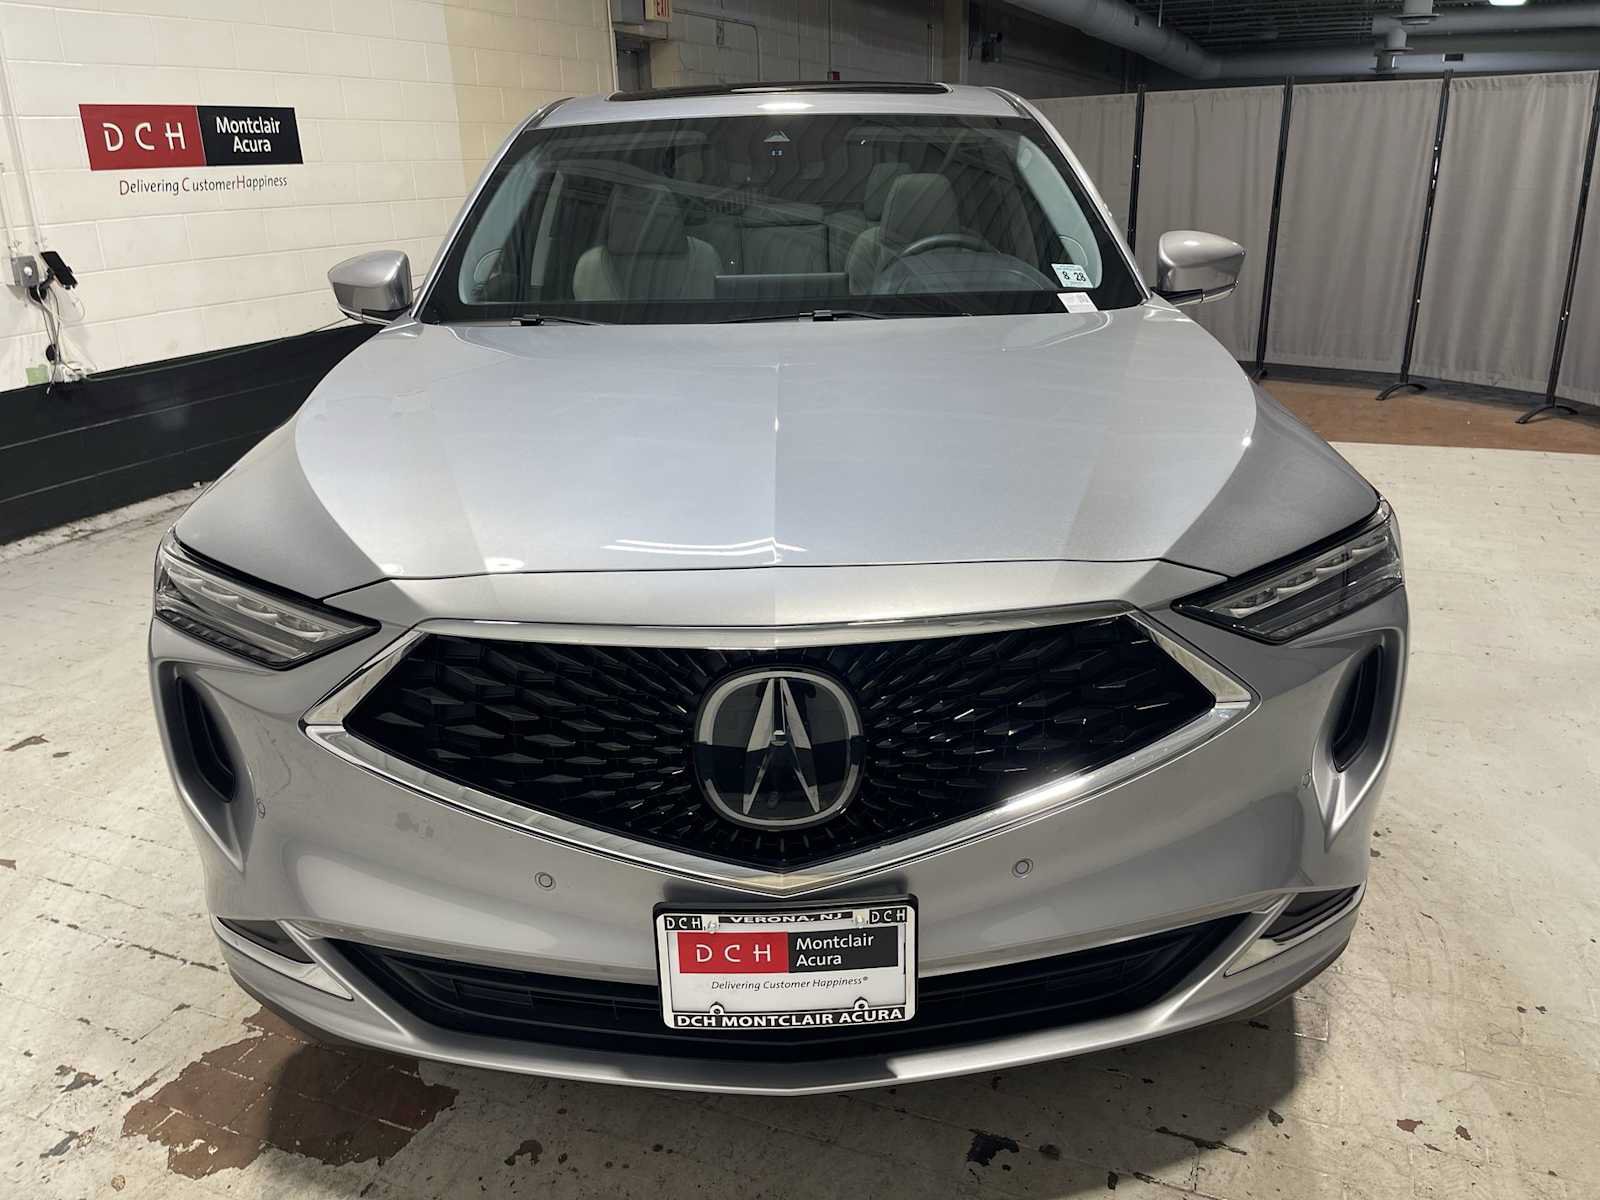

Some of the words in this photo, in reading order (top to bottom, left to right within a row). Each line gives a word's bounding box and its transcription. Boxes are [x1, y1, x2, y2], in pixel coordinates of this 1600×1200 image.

[216, 116, 281, 134] Montclair
[102, 122, 186, 151] DCH
[233, 136, 272, 153] Acura
[119, 179, 179, 196] Delivering
[1062, 271, 1070, 280] 8
[1073, 272, 1086, 281] 28
[666, 917, 702, 929] DCH
[820, 913, 842, 921] NJ
[871, 909, 906, 922] DCH
[796, 933, 874, 951] Montclair
[696, 944, 772, 963] DCH
[796, 955, 842, 967] Acura
[711, 980, 760, 992] Delivering
[763, 979, 810, 989] Customer
[677, 1015, 716, 1027] DCH
[721, 1013, 834, 1027] MONTCLAIR
[838, 1009, 902, 1024] ACURA
